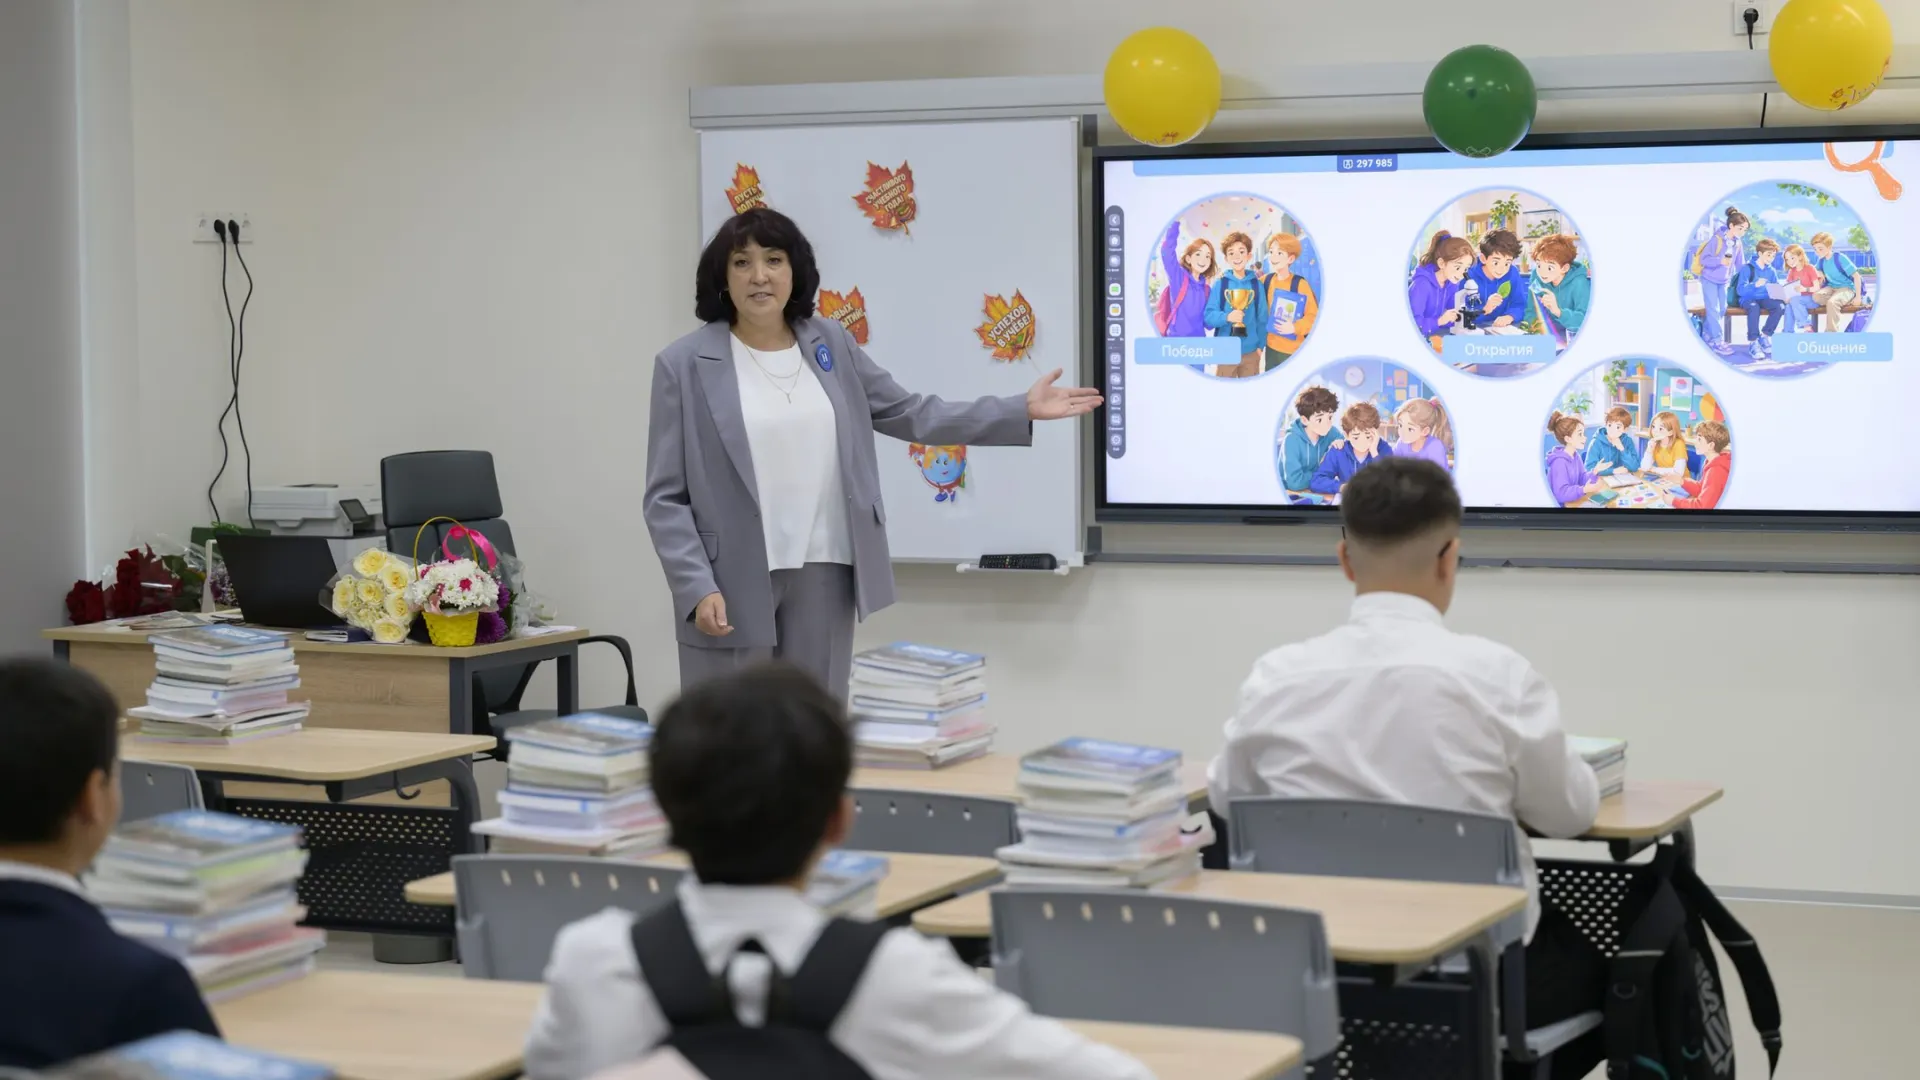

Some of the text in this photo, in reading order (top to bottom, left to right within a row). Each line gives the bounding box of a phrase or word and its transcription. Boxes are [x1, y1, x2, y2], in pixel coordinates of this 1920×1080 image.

[1356, 158, 1392, 168] 297 985
[734, 186, 758, 204] ПУСТЬ
[866, 174, 906, 204] СЧАСТЛИВОГО
[873, 184, 906, 210] УЧЕБНОГО
[884, 195, 905, 212] ГОДА!
[988, 304, 1027, 340] УСПЕХОВ
[997, 338, 1007, 348] В
[1161, 344, 1214, 358] Победы
[1464, 343, 1534, 358] Открытия
[1796, 341, 1867, 356] Общение
